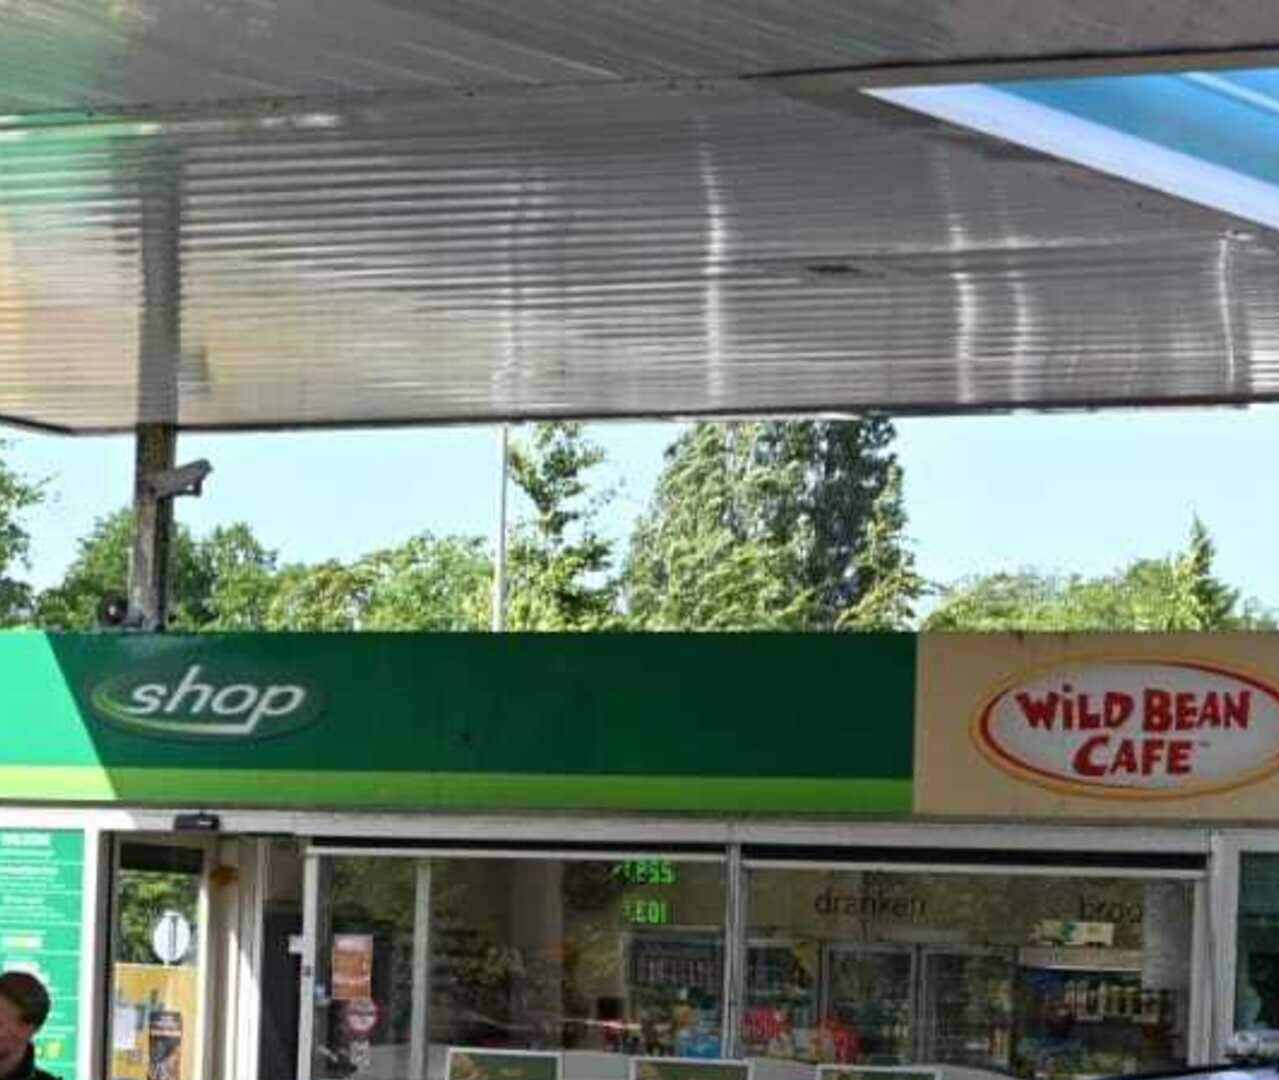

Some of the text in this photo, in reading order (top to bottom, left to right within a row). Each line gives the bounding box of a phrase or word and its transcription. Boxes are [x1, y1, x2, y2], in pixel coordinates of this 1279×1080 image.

[125, 664, 307, 735] shop
[1143, 688, 1251, 732] BEAN
[1073, 735, 1193, 776] CAFE
